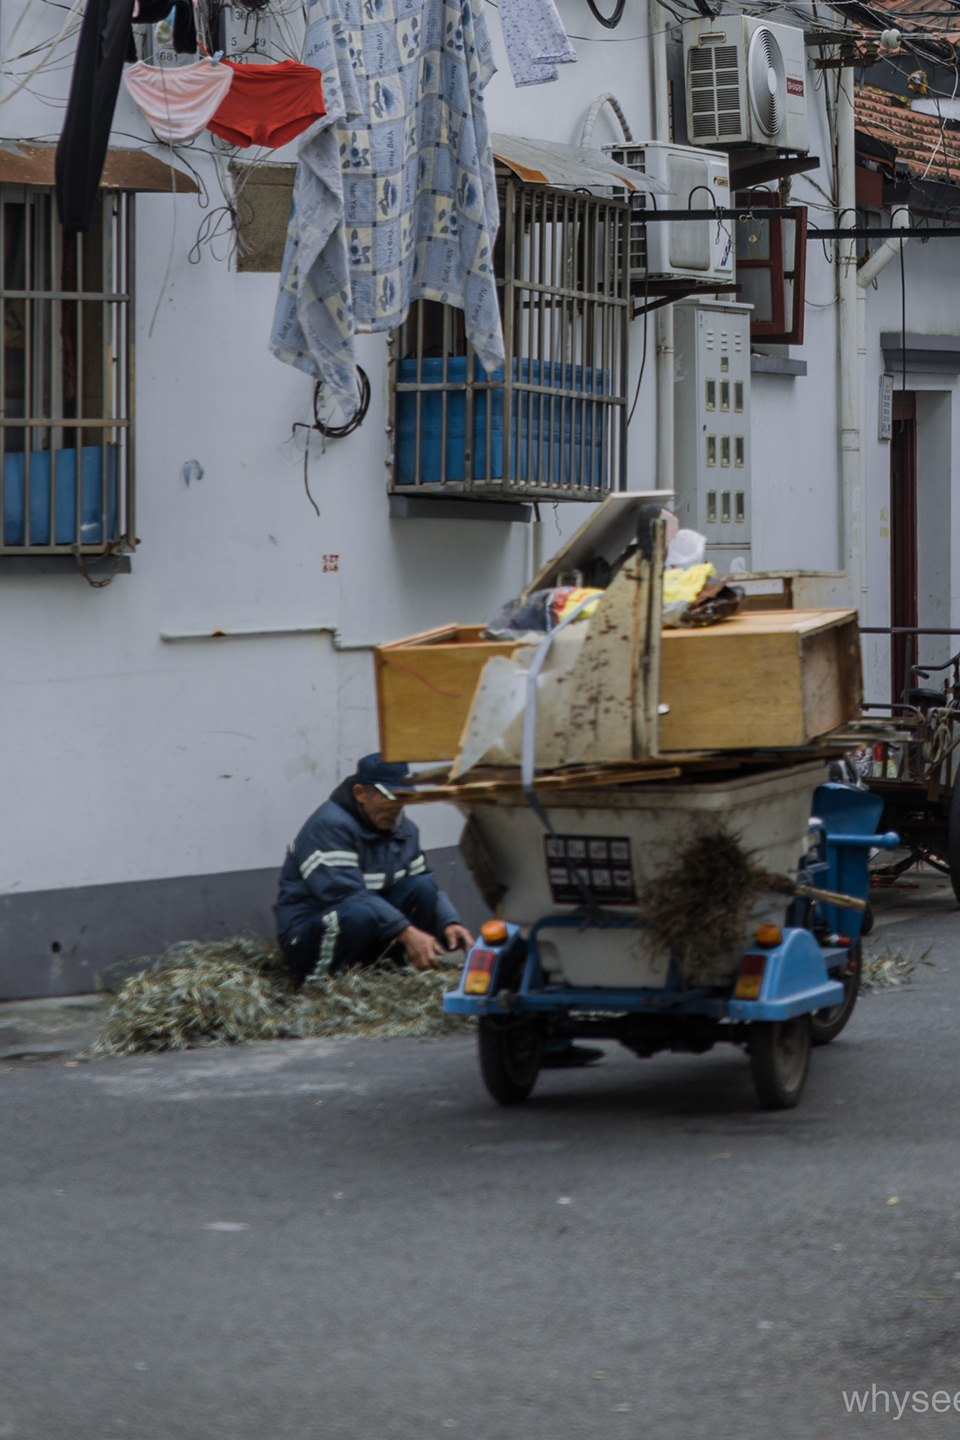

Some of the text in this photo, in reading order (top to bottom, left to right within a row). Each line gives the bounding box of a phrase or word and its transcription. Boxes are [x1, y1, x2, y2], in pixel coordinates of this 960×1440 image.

[376, 32, 386, 70] Ying Hua
[386, 130, 396, 168] Ying Hua
[348, 182, 358, 220] Nan Yang
[442, 248, 455, 283] Nan Yang
[471, 287, 488, 322] Nan Yang
